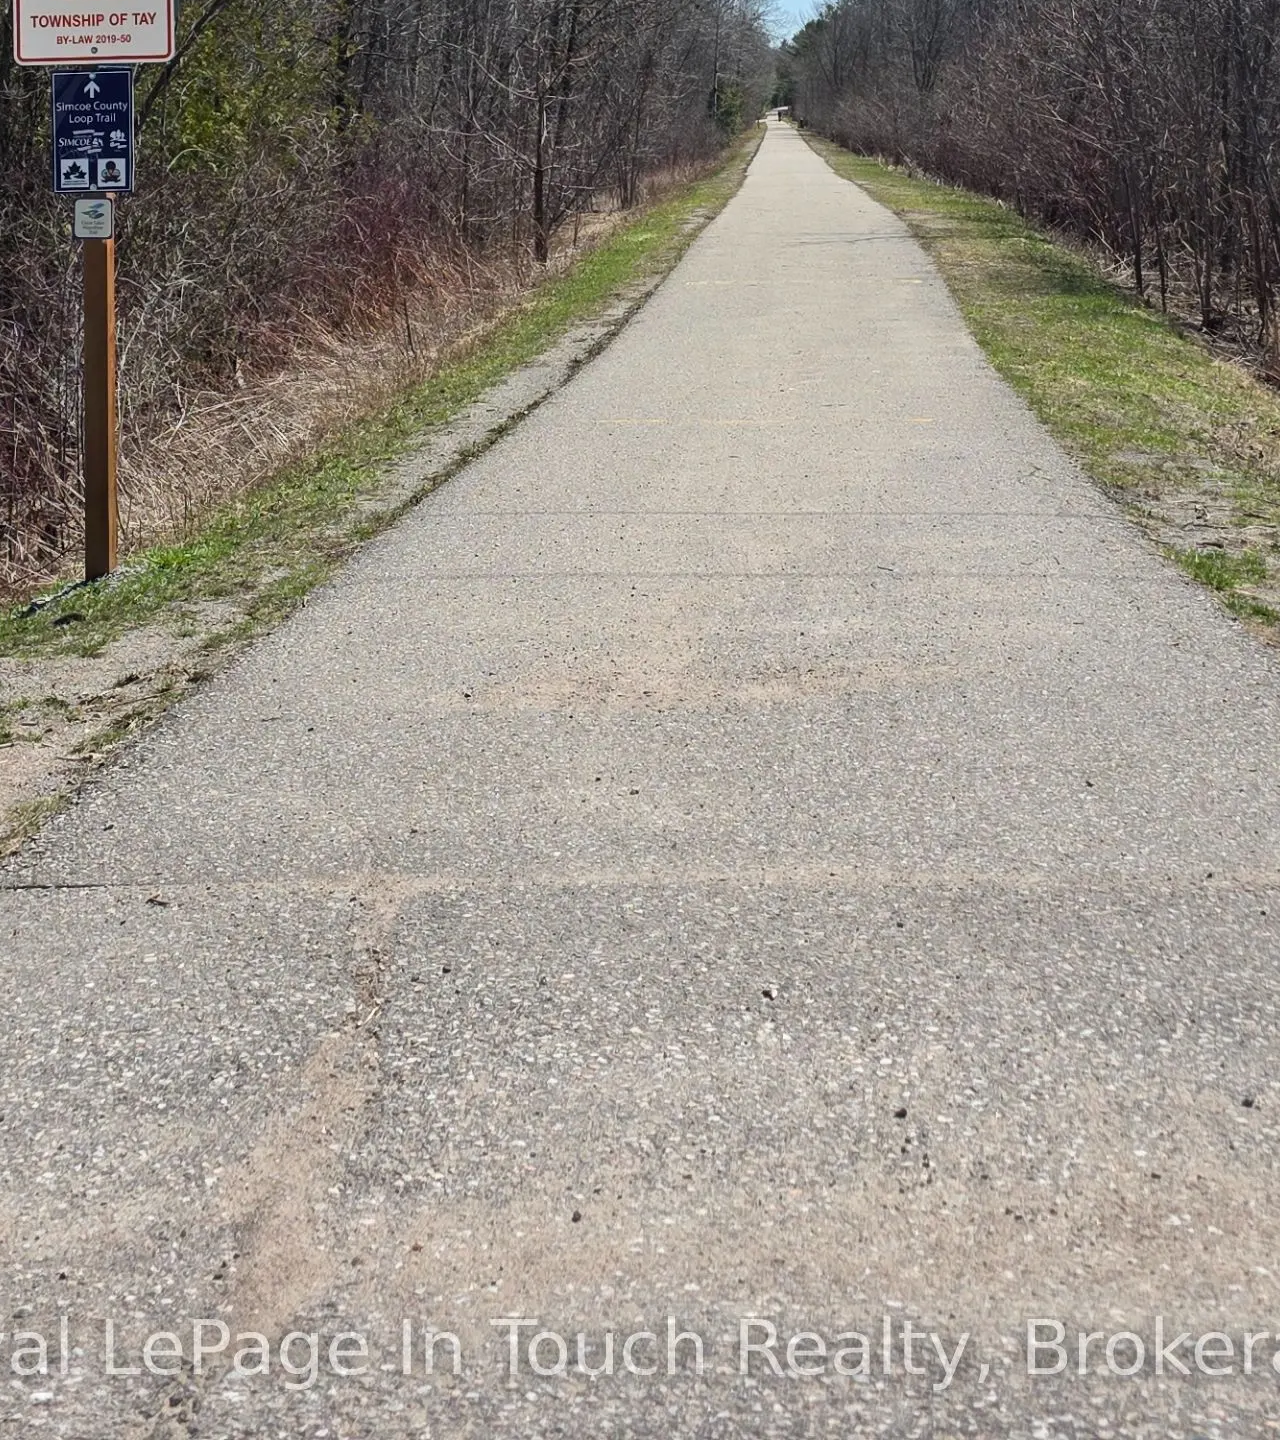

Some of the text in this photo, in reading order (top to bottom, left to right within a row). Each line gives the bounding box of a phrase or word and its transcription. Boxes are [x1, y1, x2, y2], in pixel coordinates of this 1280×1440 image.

[30, 12, 157, 28] TOWNSHIP OF TAY
[56, 33, 132, 45] BY-LAW 2019-50
[55, 100, 128, 112] Simcoe County
[69, 112, 116, 125] Loop Trail
